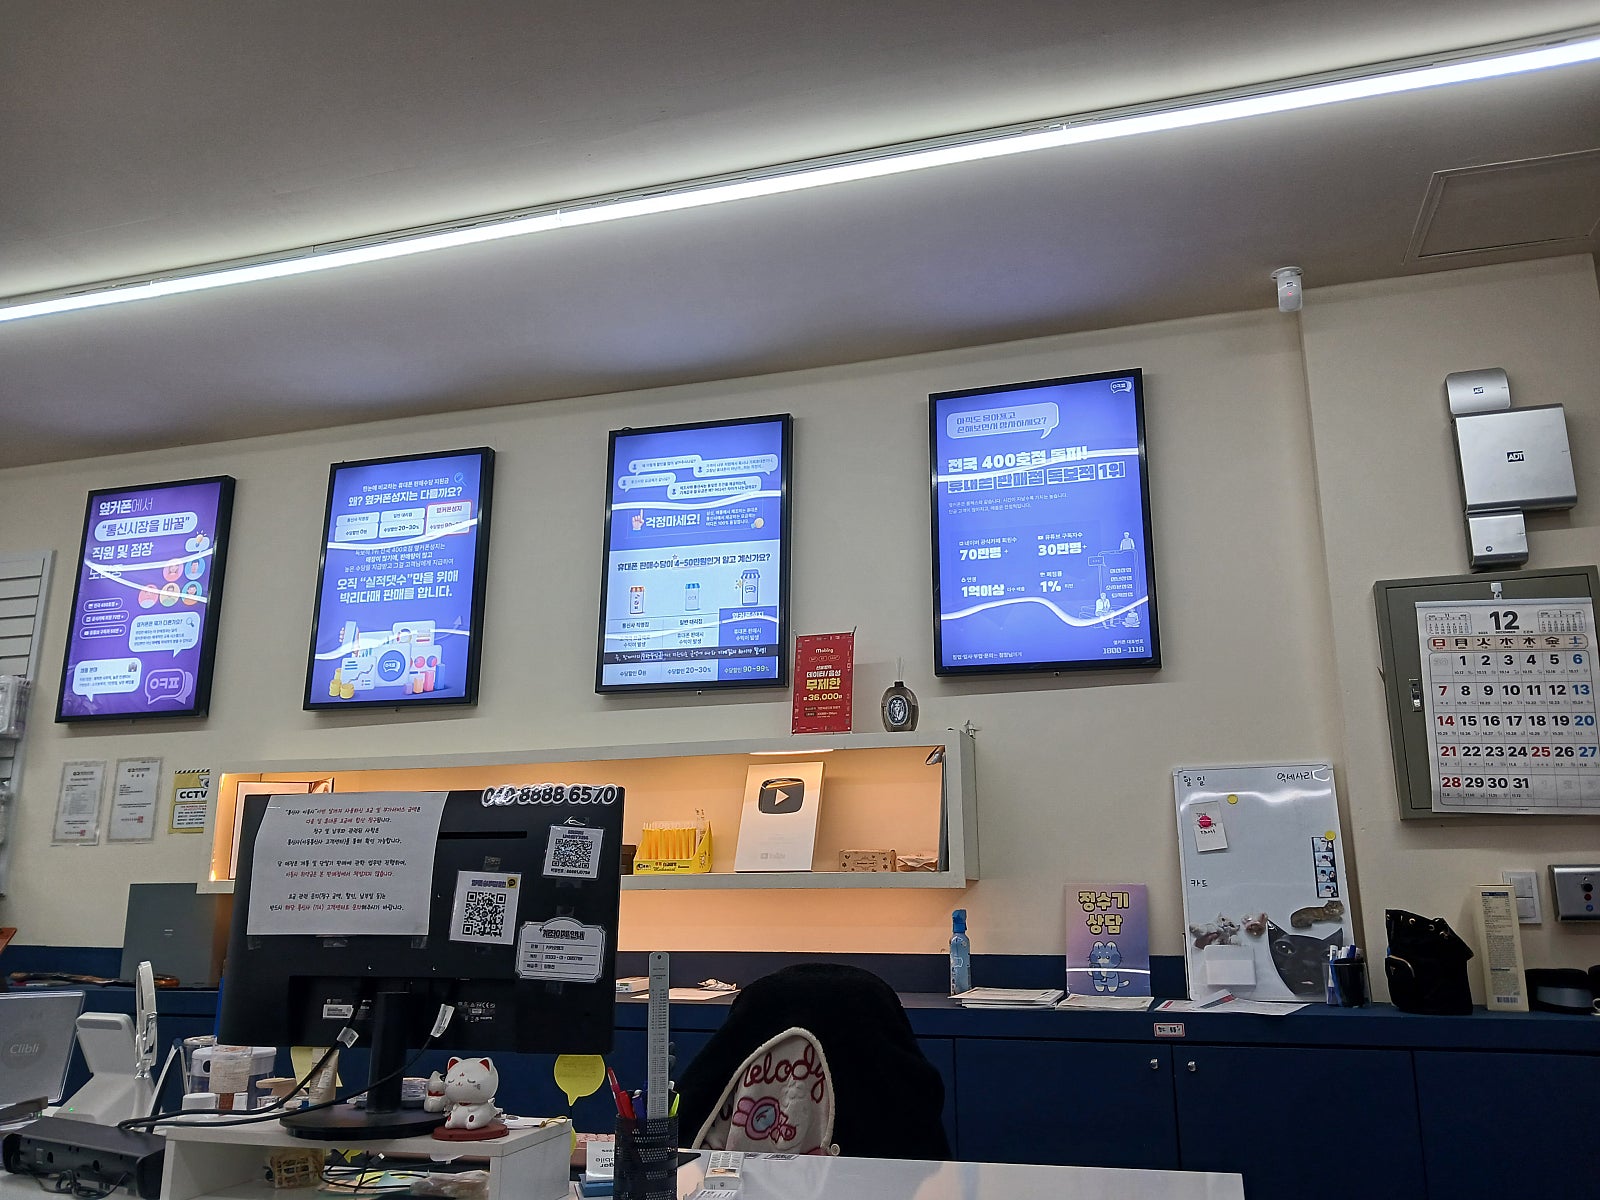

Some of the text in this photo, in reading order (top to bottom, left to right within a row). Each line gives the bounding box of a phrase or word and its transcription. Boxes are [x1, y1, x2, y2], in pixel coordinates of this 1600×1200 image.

[949, 457, 977, 472] 전국
[982, 450, 1046, 469] 400호점
[1508, 452, 1524, 461] ADT
[997, 469, 1044, 489] 판매점
[1047, 464, 1096, 484] 독보적
[1098, 461, 1125, 479] 1위
[348, 487, 462, 506] 왜? 옆커폰성지는 다를까요?
[99, 498, 152, 515] 옆커폰에서
[102, 517, 190, 537] “통신시장을 바꿀”
[646, 513, 700, 528] 걱정마세요!
[92, 542, 153, 560] 직원 및 점장
[960, 547, 1002, 561] 70만명
[618, 562, 638, 571] 휴대폰
[640, 560, 673, 570] 판매수당이
[722, 555, 736, 564] 알고
[738, 553, 770, 562] 계신가요?
[337, 577, 357, 590] 오직
[961, 584, 1005, 597] 1억이상
[1040, 581, 1061, 592] 1%
[340, 585, 452, 604] 박리다매 판매를 합니다.
[1490, 611, 1519, 630] 12
[1455, 638, 1468, 646] 月
[1545, 637, 1560, 645] 金
[1569, 636, 1583, 645] 土
[1460, 654, 1582, 665] 1 2 3 4 5 6
[806, 678, 841, 690] 무제한
[1438, 685, 1590, 696] 7 8 9 10 11 12 13
[1437, 716, 1594, 726] 14 15 16 17 18 19 20
[1441, 747, 1597, 757] 21 22 23 24 25 26 27
[1197, 775, 1205, 786] 일
[1442, 778, 1529, 788] 28 29 30 31
[569, 786, 616, 803] 6570
[1190, 879, 1208, 888] 카드
[1078, 891, 1130, 912] 정수기
[1086, 914, 1123, 934] 상담
[10, 1043, 40, 1054] Clibli
[744, 1044, 826, 1104] elody
